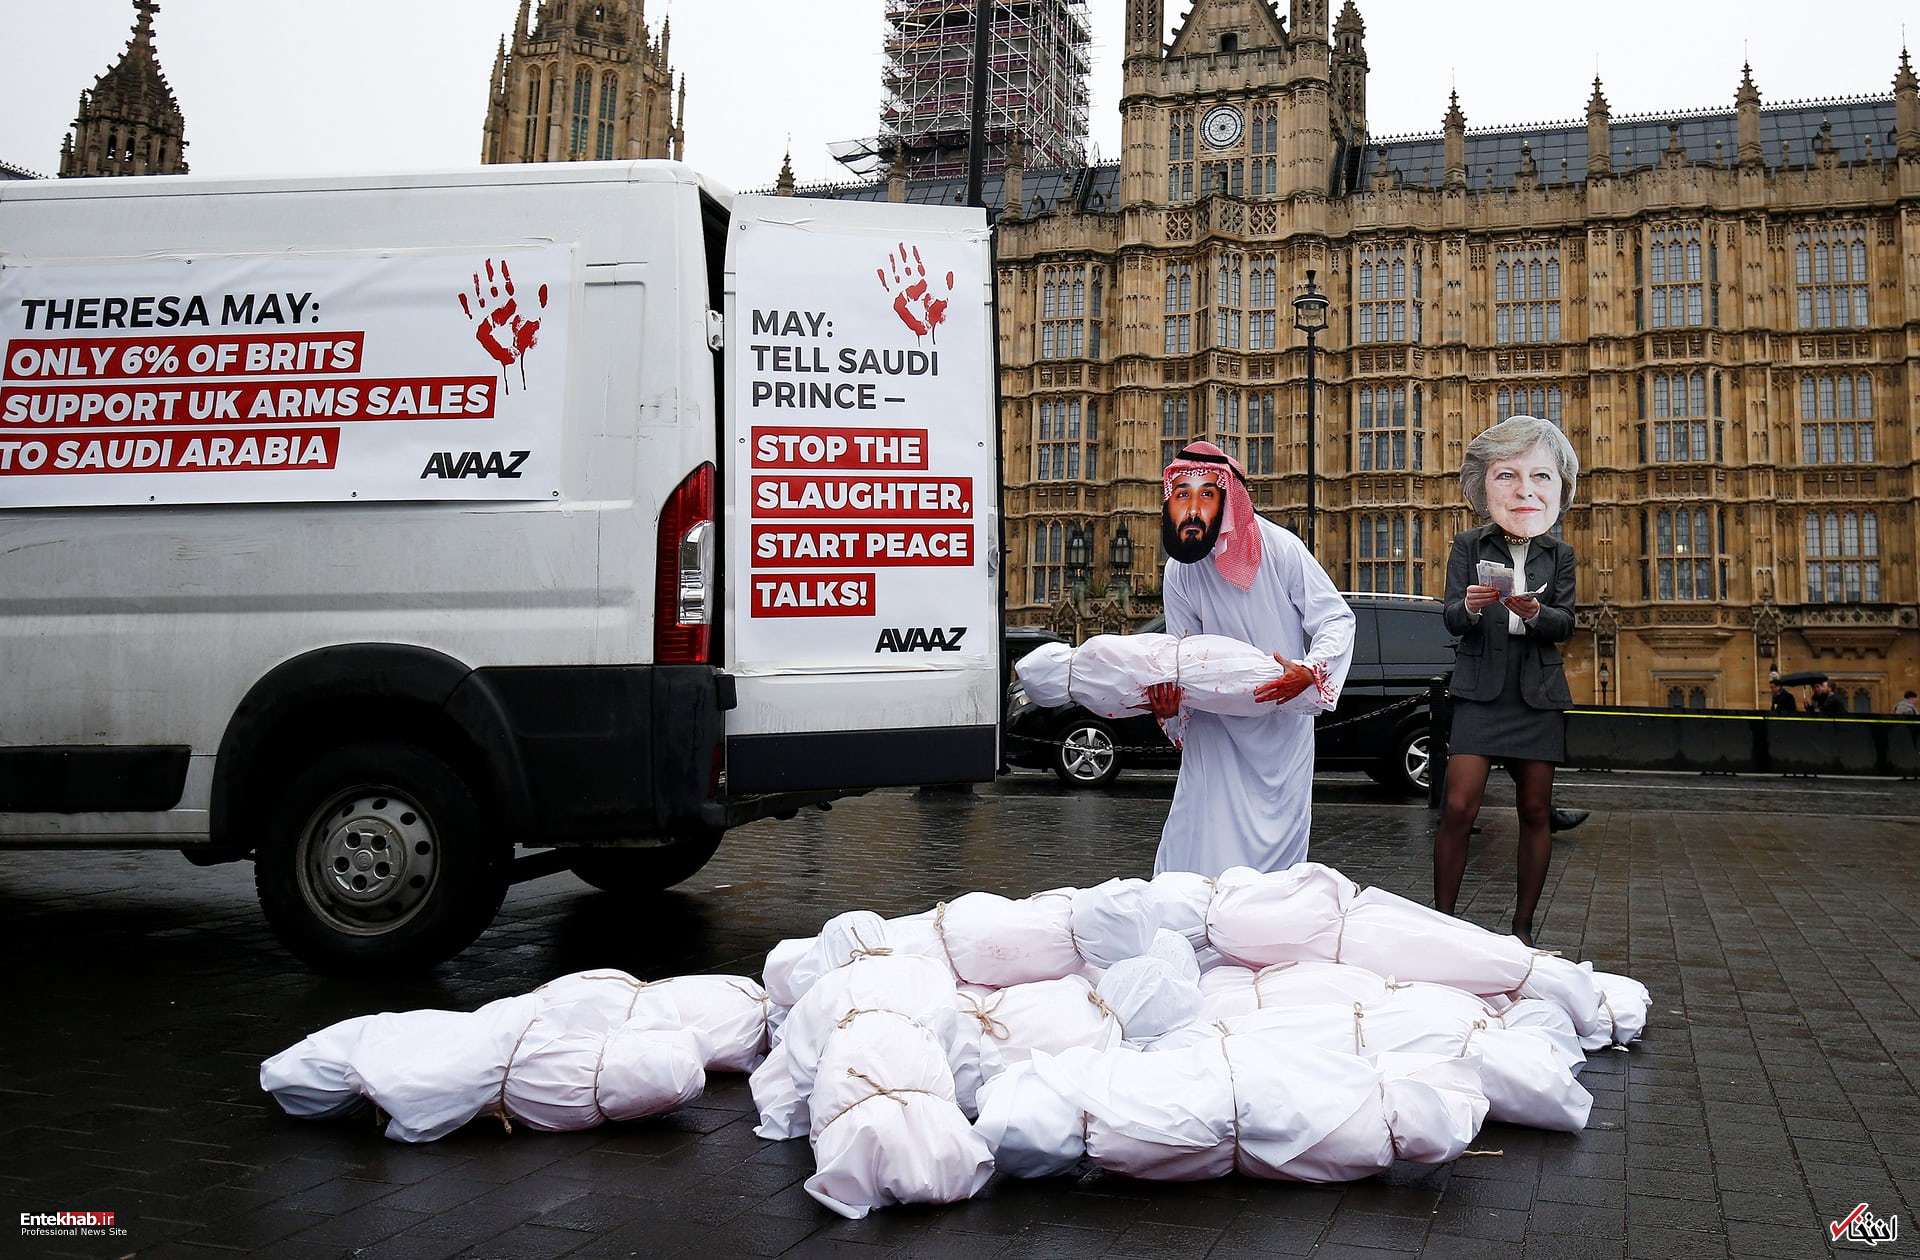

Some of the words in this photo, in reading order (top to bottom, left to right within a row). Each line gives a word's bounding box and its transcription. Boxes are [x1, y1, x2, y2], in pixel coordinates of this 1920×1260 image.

[21, 295, 210, 330] THERESA
[221, 293, 320, 326] MAY:
[752, 309, 833, 338] MAY:
[10, 346, 117, 376] ONLY
[121, 344, 180, 374] 6%
[187, 343, 239, 372] OF
[245, 341, 356, 371] BRITS
[750, 344, 830, 373] TELL
[837, 347, 938, 376] SAUDI
[2, 392, 180, 423] SUPPORT
[188, 389, 240, 420] UK
[248, 386, 358, 417] ARMS
[365, 383, 490, 415] SALES
[752, 380, 877, 410] PRINCE
[0, 441, 48, 470] TO
[53, 438, 172, 469] SAUDI
[177, 436, 328, 467] ARABIA
[756, 434, 847, 463] STOP
[854, 436, 921, 464] THE
[420, 450, 531, 480] AVAAZ
[756, 481, 970, 514] SLAUGHTER,
[756, 532, 859, 559] START
[866, 532, 968, 558] PEACE
[756, 580, 867, 608] TALKS!
[874, 626, 968, 654] AVAAZ
